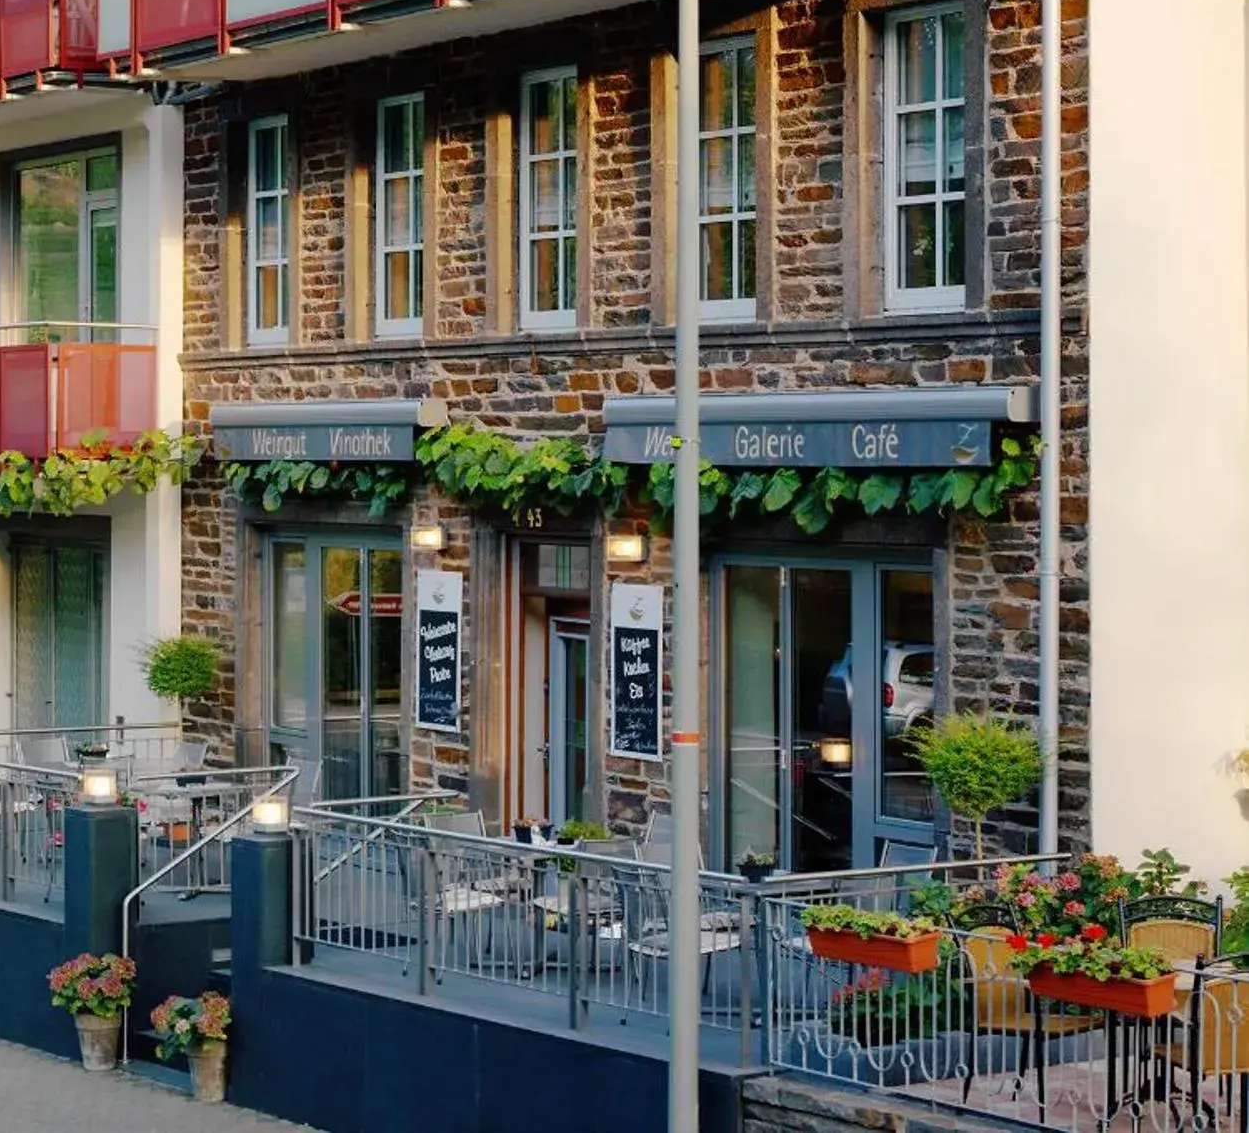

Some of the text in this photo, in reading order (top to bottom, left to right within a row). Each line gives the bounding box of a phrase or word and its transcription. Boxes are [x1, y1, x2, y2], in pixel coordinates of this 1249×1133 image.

[252, 427, 392, 458] Weingut Vinothek
[735, 425, 805, 459] Galerie
[852, 424, 900, 459] Café
